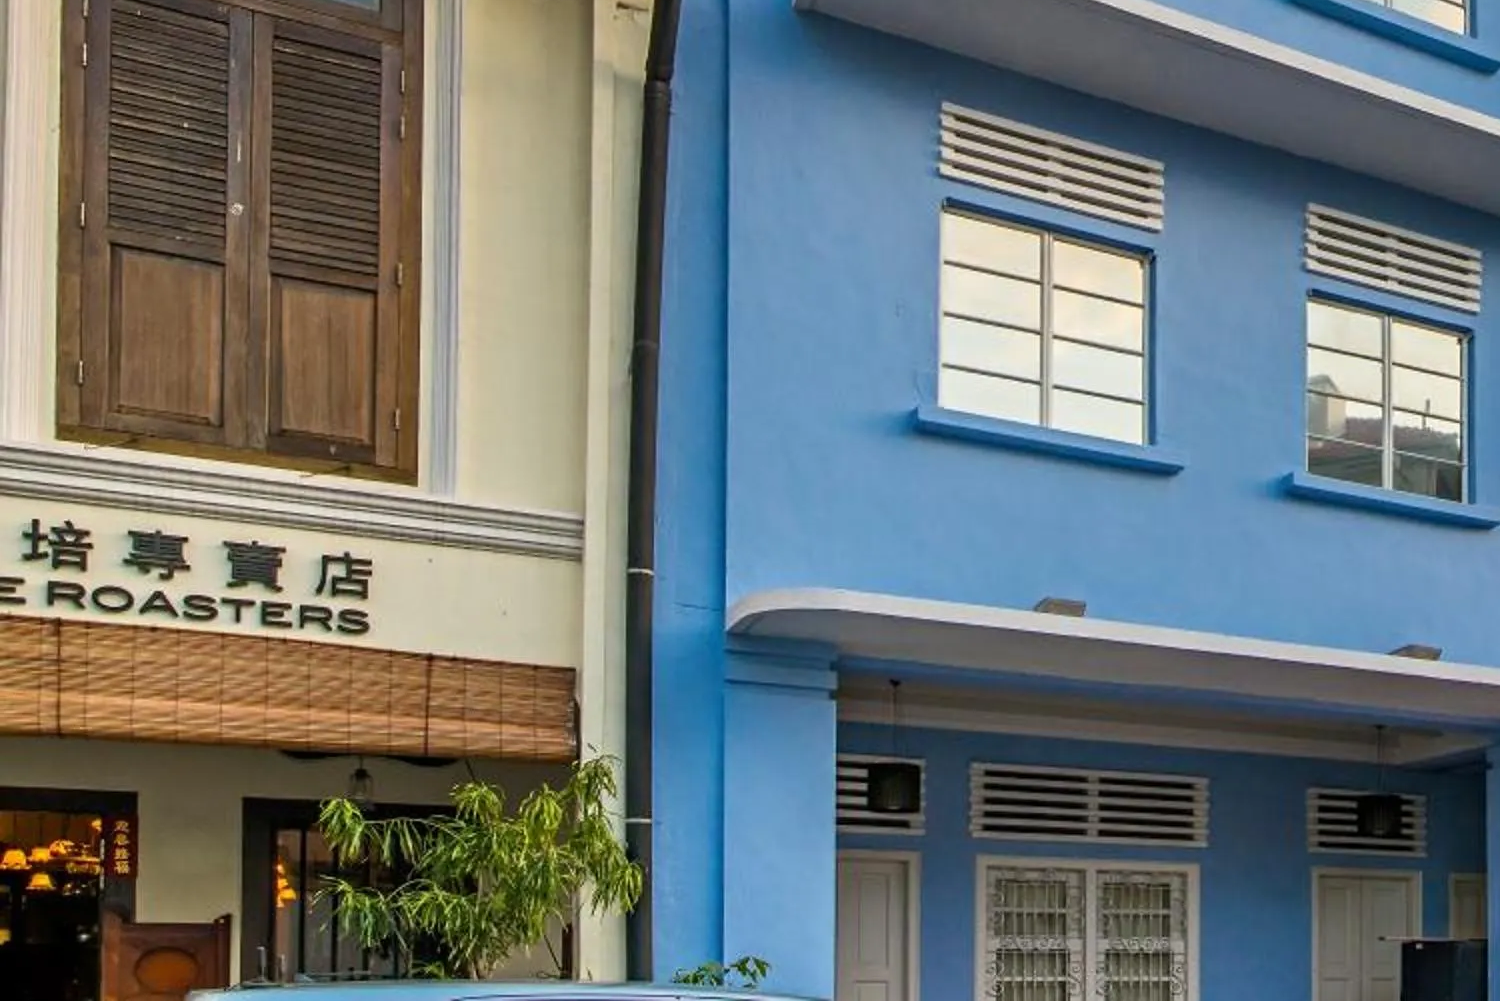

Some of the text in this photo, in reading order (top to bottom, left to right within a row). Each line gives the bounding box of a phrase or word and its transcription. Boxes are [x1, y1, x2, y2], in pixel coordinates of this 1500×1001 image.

[22, 518, 374, 600] 培專賣店
[47, 580, 370, 634] ROASTERS
